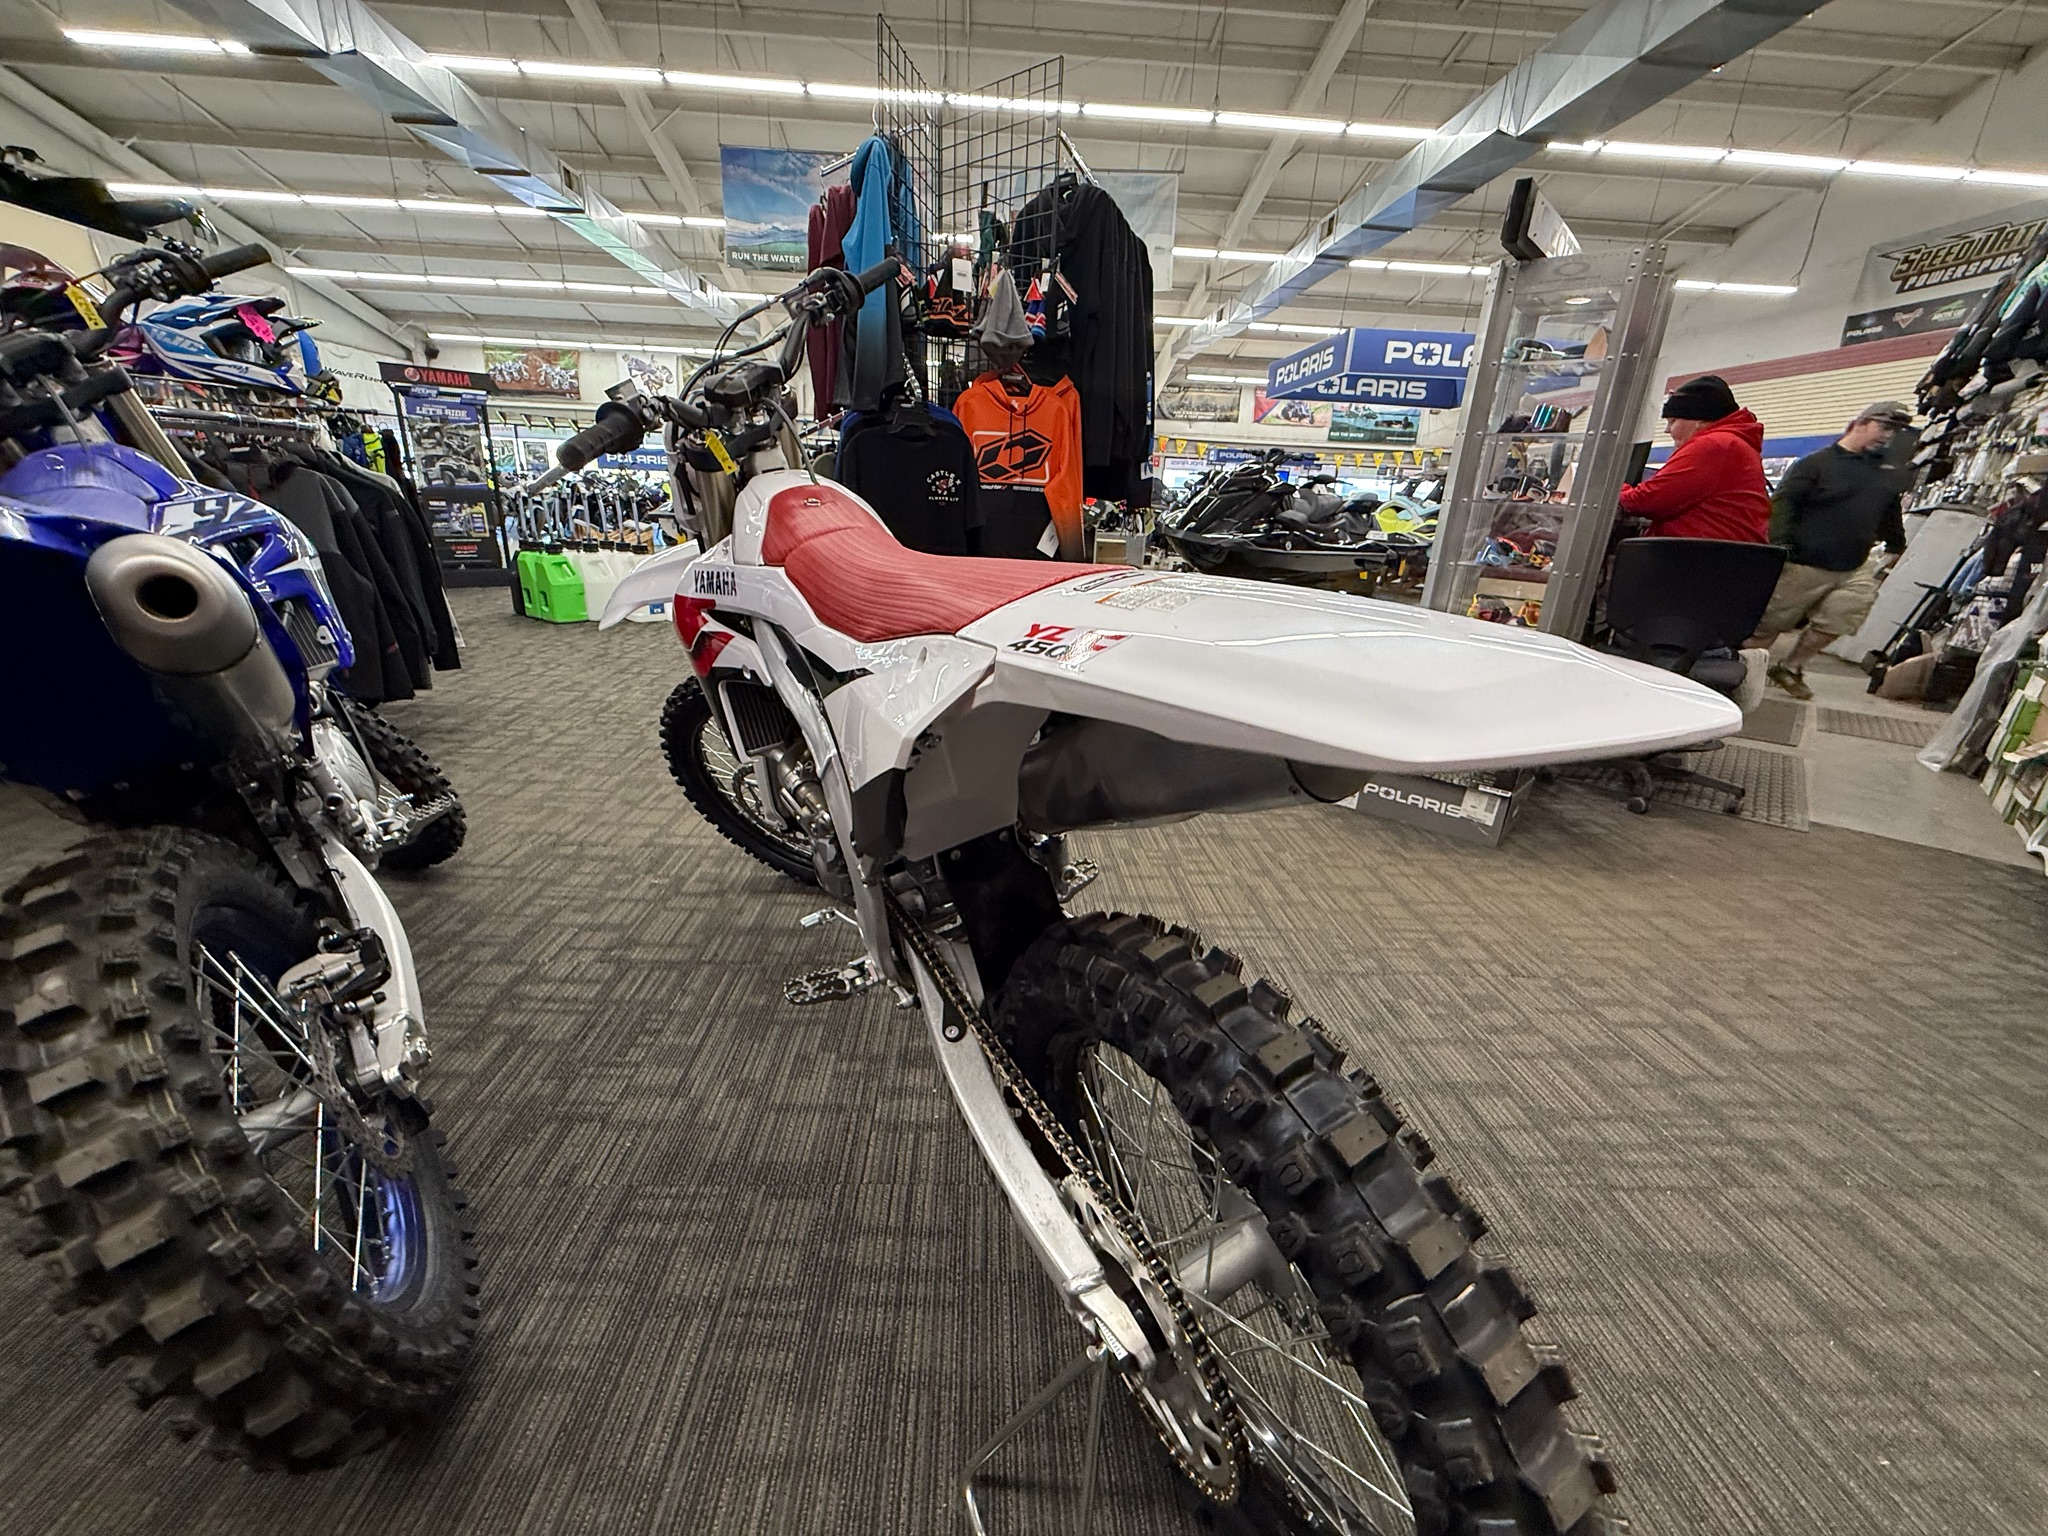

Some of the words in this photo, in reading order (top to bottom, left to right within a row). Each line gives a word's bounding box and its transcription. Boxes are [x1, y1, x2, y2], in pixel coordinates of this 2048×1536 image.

[731, 251, 750, 260] RUN
[752, 253, 769, 262] THE
[151, 327, 205, 352] HJC
[1845, 325, 1883, 338] POLARIS
[1275, 346, 1335, 387] POLARIS
[420, 369, 472, 387] YAMAHA
[1296, 377, 1427, 400] OLARIS
[444, 408, 468, 417] RIDE
[606, 453, 669, 465] POLARIS
[926, 470, 956, 483] CASTLE
[694, 570, 737, 597] YAMAHA
[1024, 623, 1076, 642] YZ
[1363, 782, 1462, 819] POLARIS
